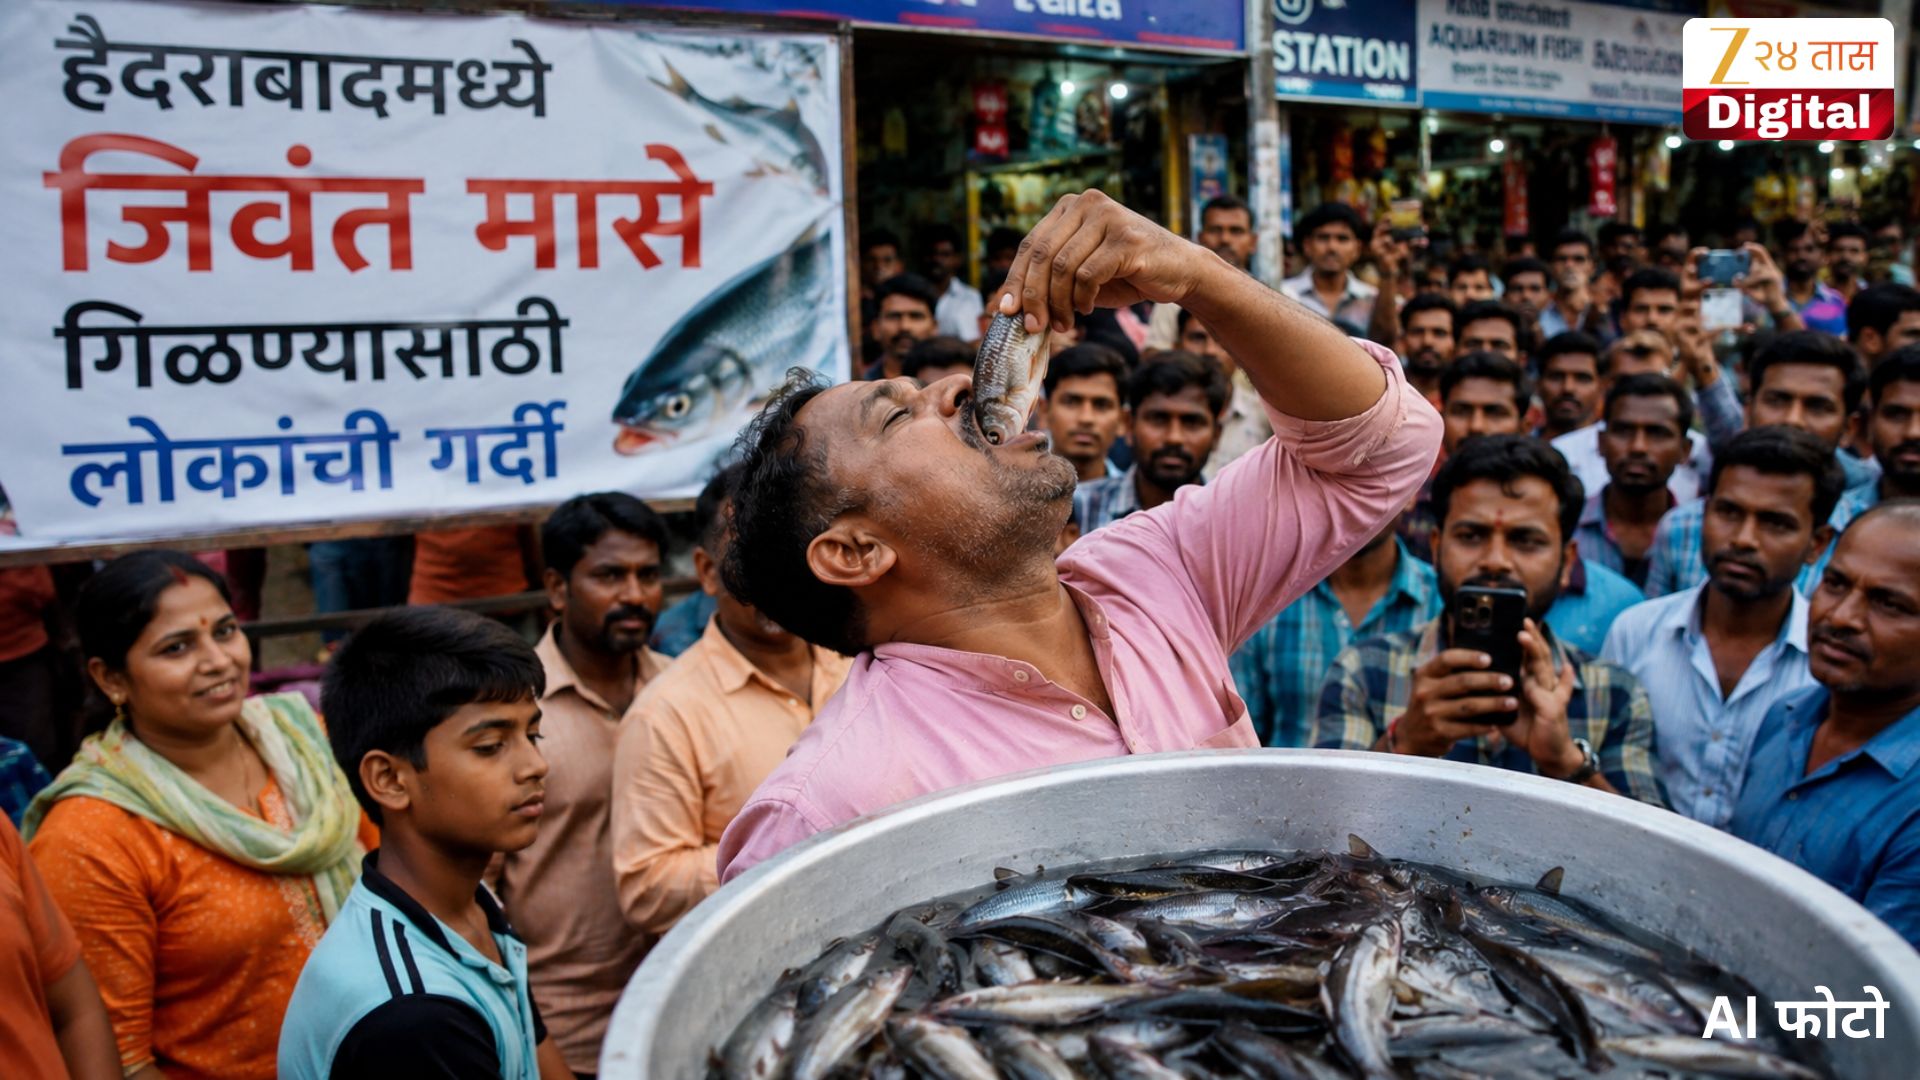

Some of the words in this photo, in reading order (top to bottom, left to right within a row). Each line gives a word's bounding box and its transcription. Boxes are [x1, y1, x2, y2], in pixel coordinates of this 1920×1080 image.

[54, 14, 553, 118] हैदराबादमध्ये
[1272, 29, 1410, 81] STATION
[43, 133, 426, 273] जिवंत
[466, 143, 714, 270] मासे
[53, 297, 570, 390] गिळण्यासाठी
[61, 407, 400, 509] लोकांची
[424, 400, 568, 486] गर्दी
